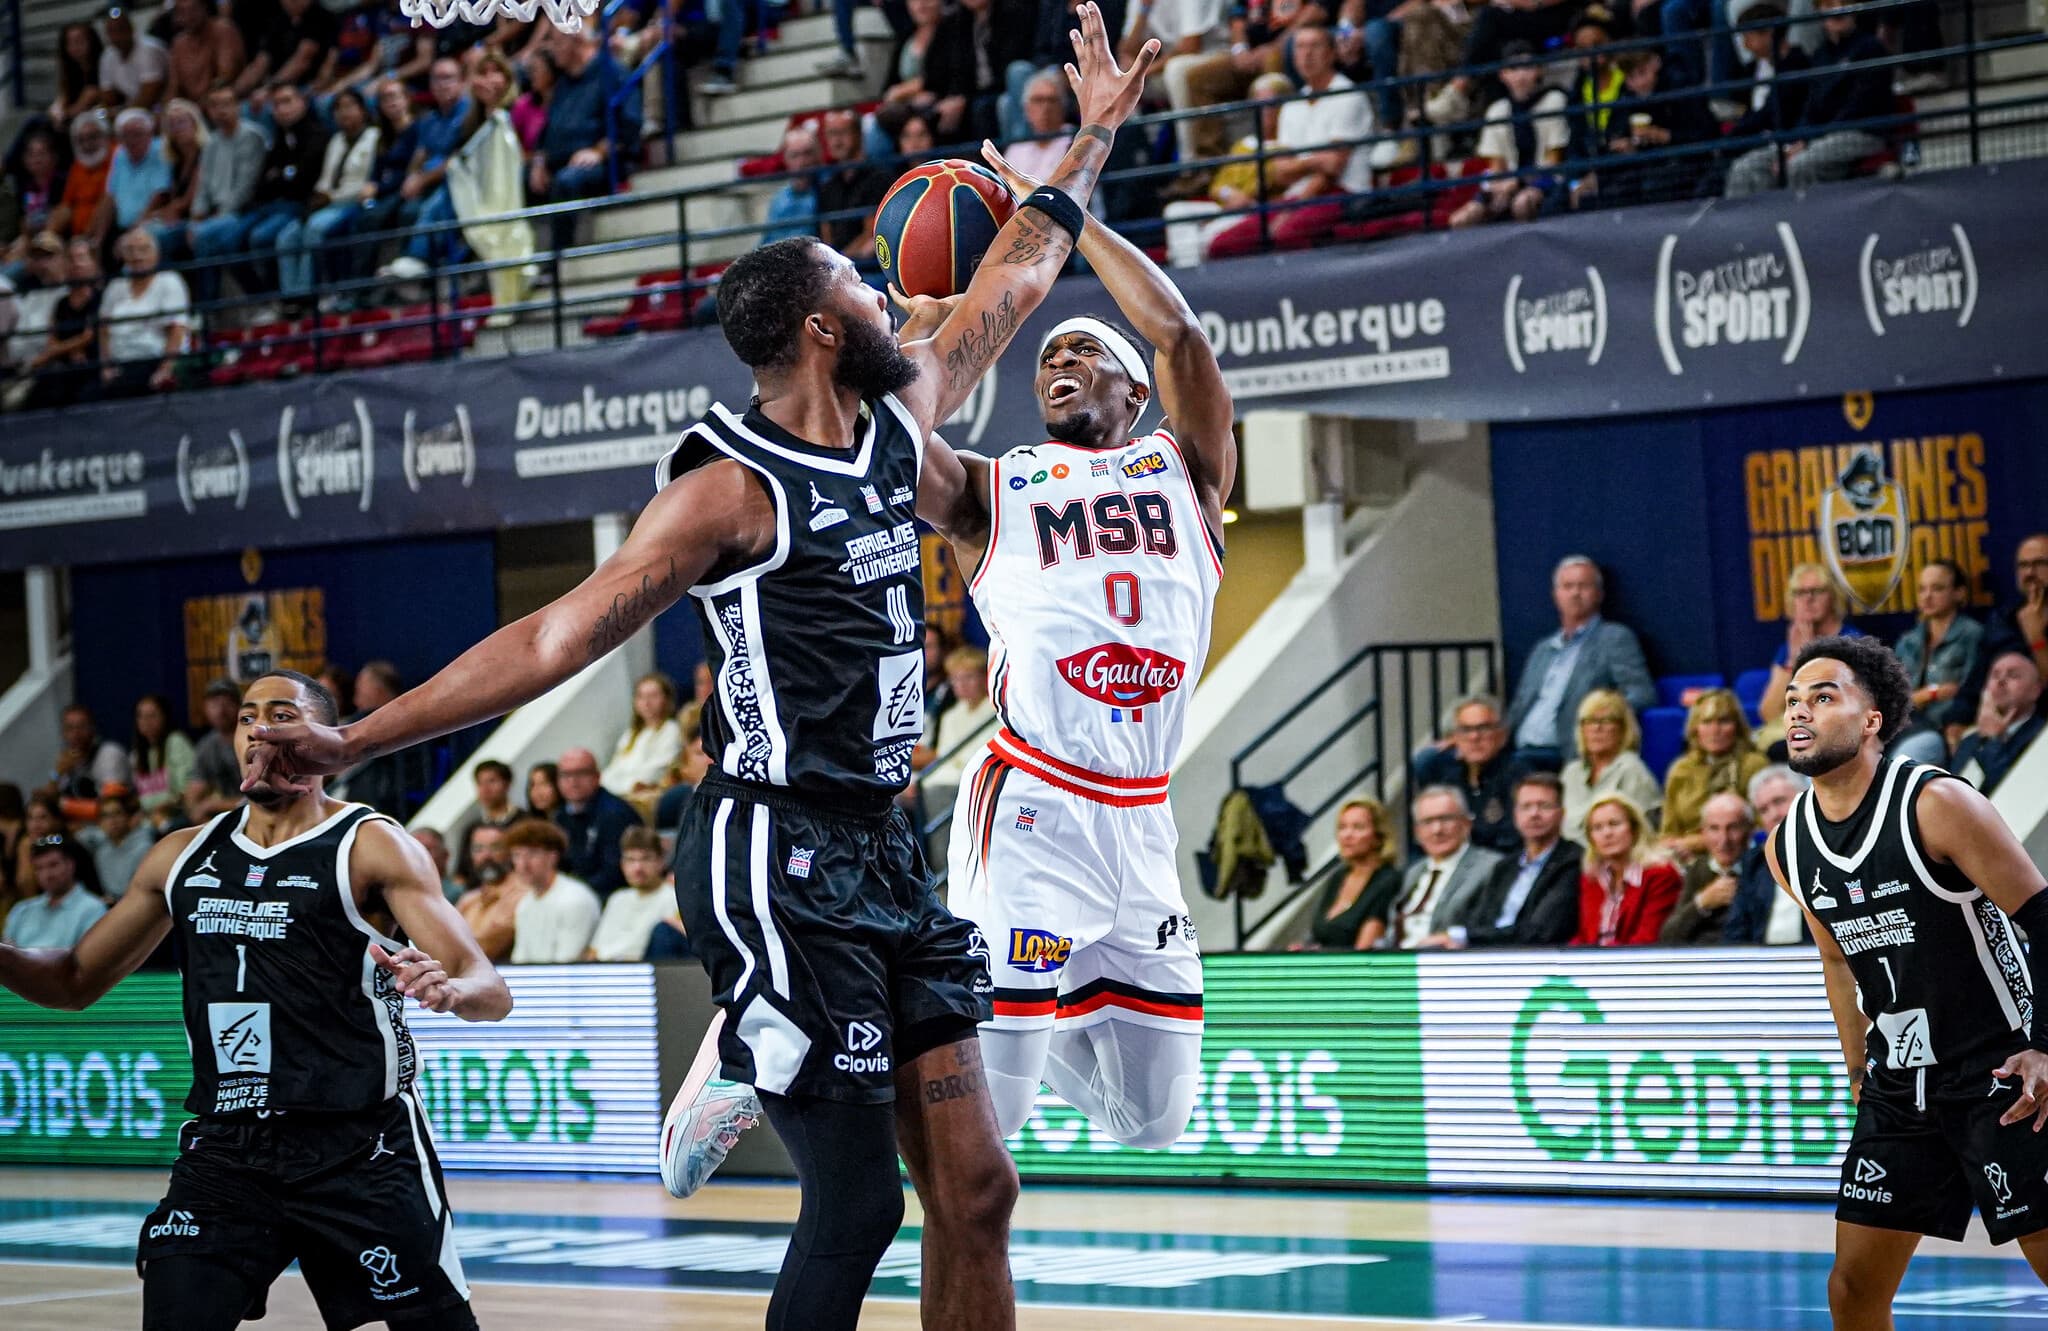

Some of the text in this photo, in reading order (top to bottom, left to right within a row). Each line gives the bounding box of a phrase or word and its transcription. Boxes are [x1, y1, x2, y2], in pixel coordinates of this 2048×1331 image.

[1883, 270, 1963, 316] SPORT
[1199, 298, 1446, 358] Dunkerque
[1522, 311, 1594, 353] SPORT
[1682, 287, 1791, 347] SPORT
[514, 385, 711, 441] Dunkerque
[0, 448, 145, 495] unkerque
[297, 449, 361, 497] SPORT
[416, 441, 463, 478] SPORT
[845, 520, 917, 560] GRAVELINES
[1030, 491, 1179, 571] MSB
[1836, 519, 1896, 558] BCM
[851, 546, 921, 585] DUNKERQUE
[1102, 570, 1144, 628] 0
[1067, 650, 1179, 695] le Gaulois
[198, 897, 290, 918] GRAVELINES
[196, 917, 288, 942] DUNKERQUE
[1840, 927, 1916, 956] UNKERQUE
[236, 944, 247, 992] 1
[1878, 957, 1897, 1003] 1
[834, 1052, 889, 1073] Clovis
[214, 1097, 268, 1113] FRANCE
[216, 1085, 269, 1101] HAUTS DE
[1842, 1183, 1893, 1204] Clovis
